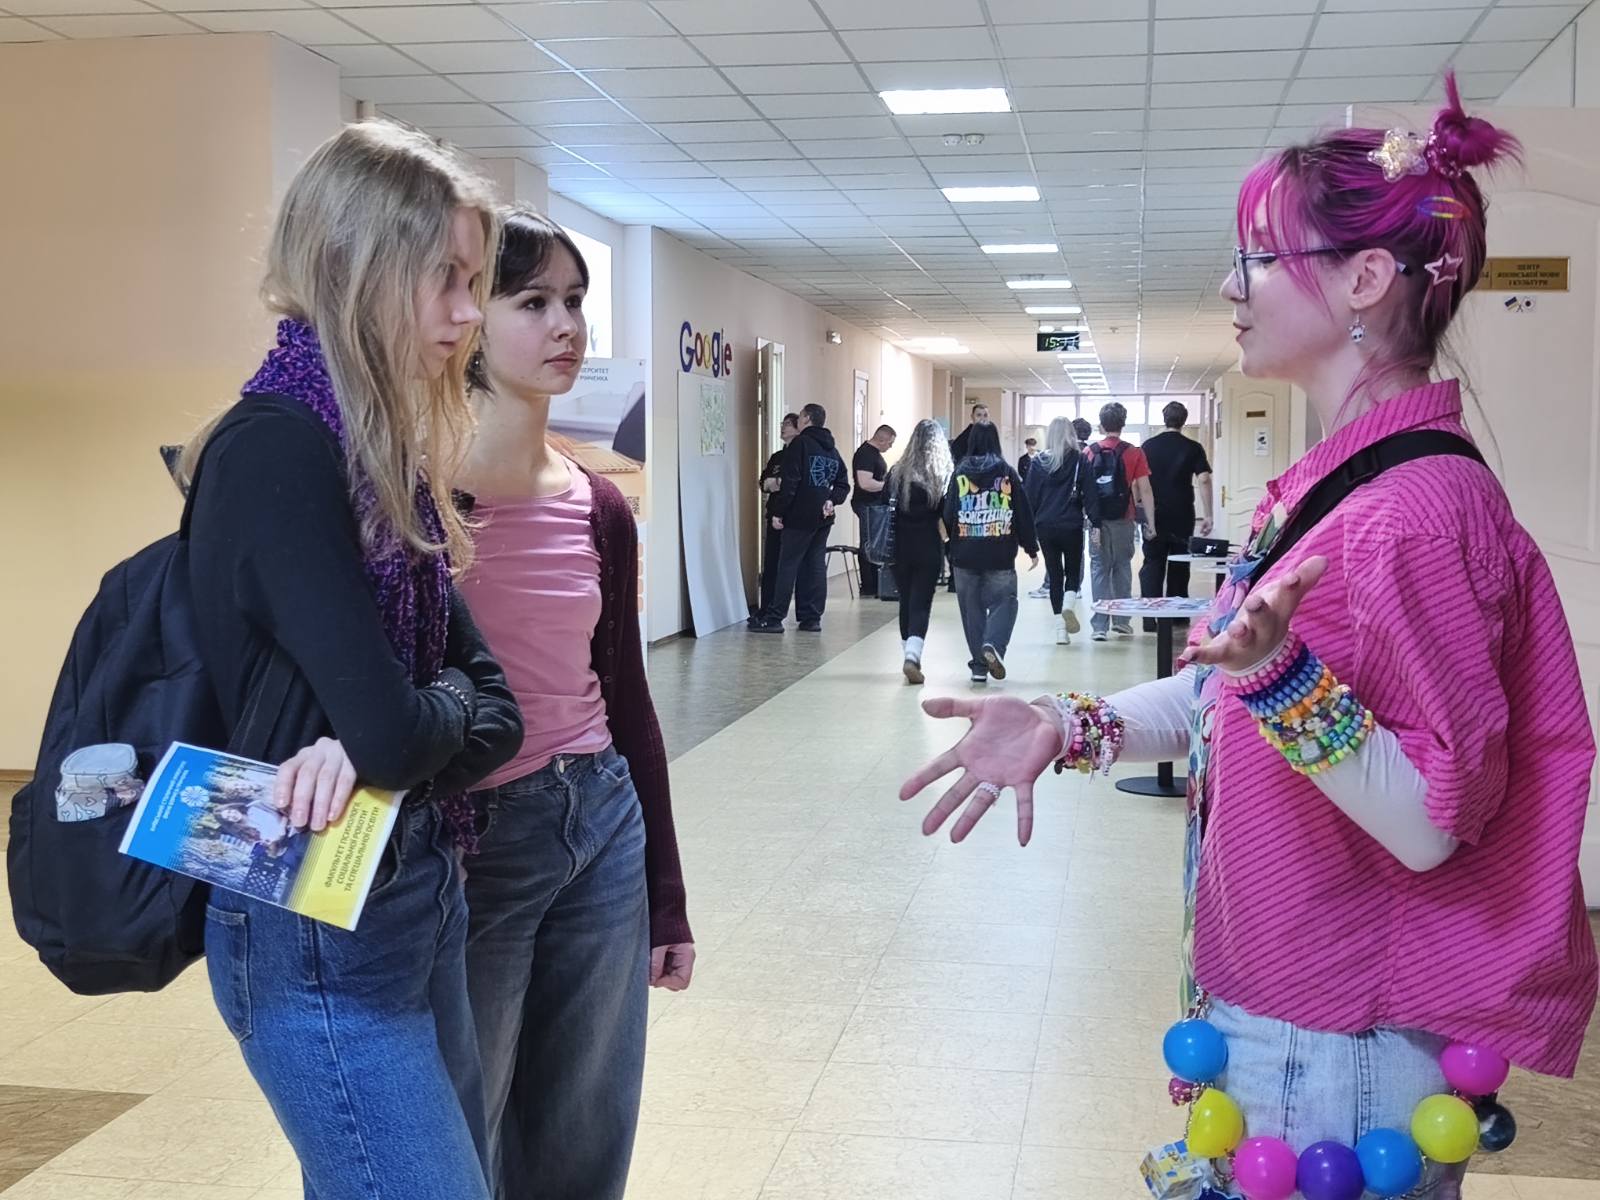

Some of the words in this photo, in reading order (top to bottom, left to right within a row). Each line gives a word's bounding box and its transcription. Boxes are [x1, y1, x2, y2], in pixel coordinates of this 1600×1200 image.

[680, 320, 732, 378] Google
[958, 509, 1013, 524] SOMETHING
[344, 881, 353, 892] ТА
